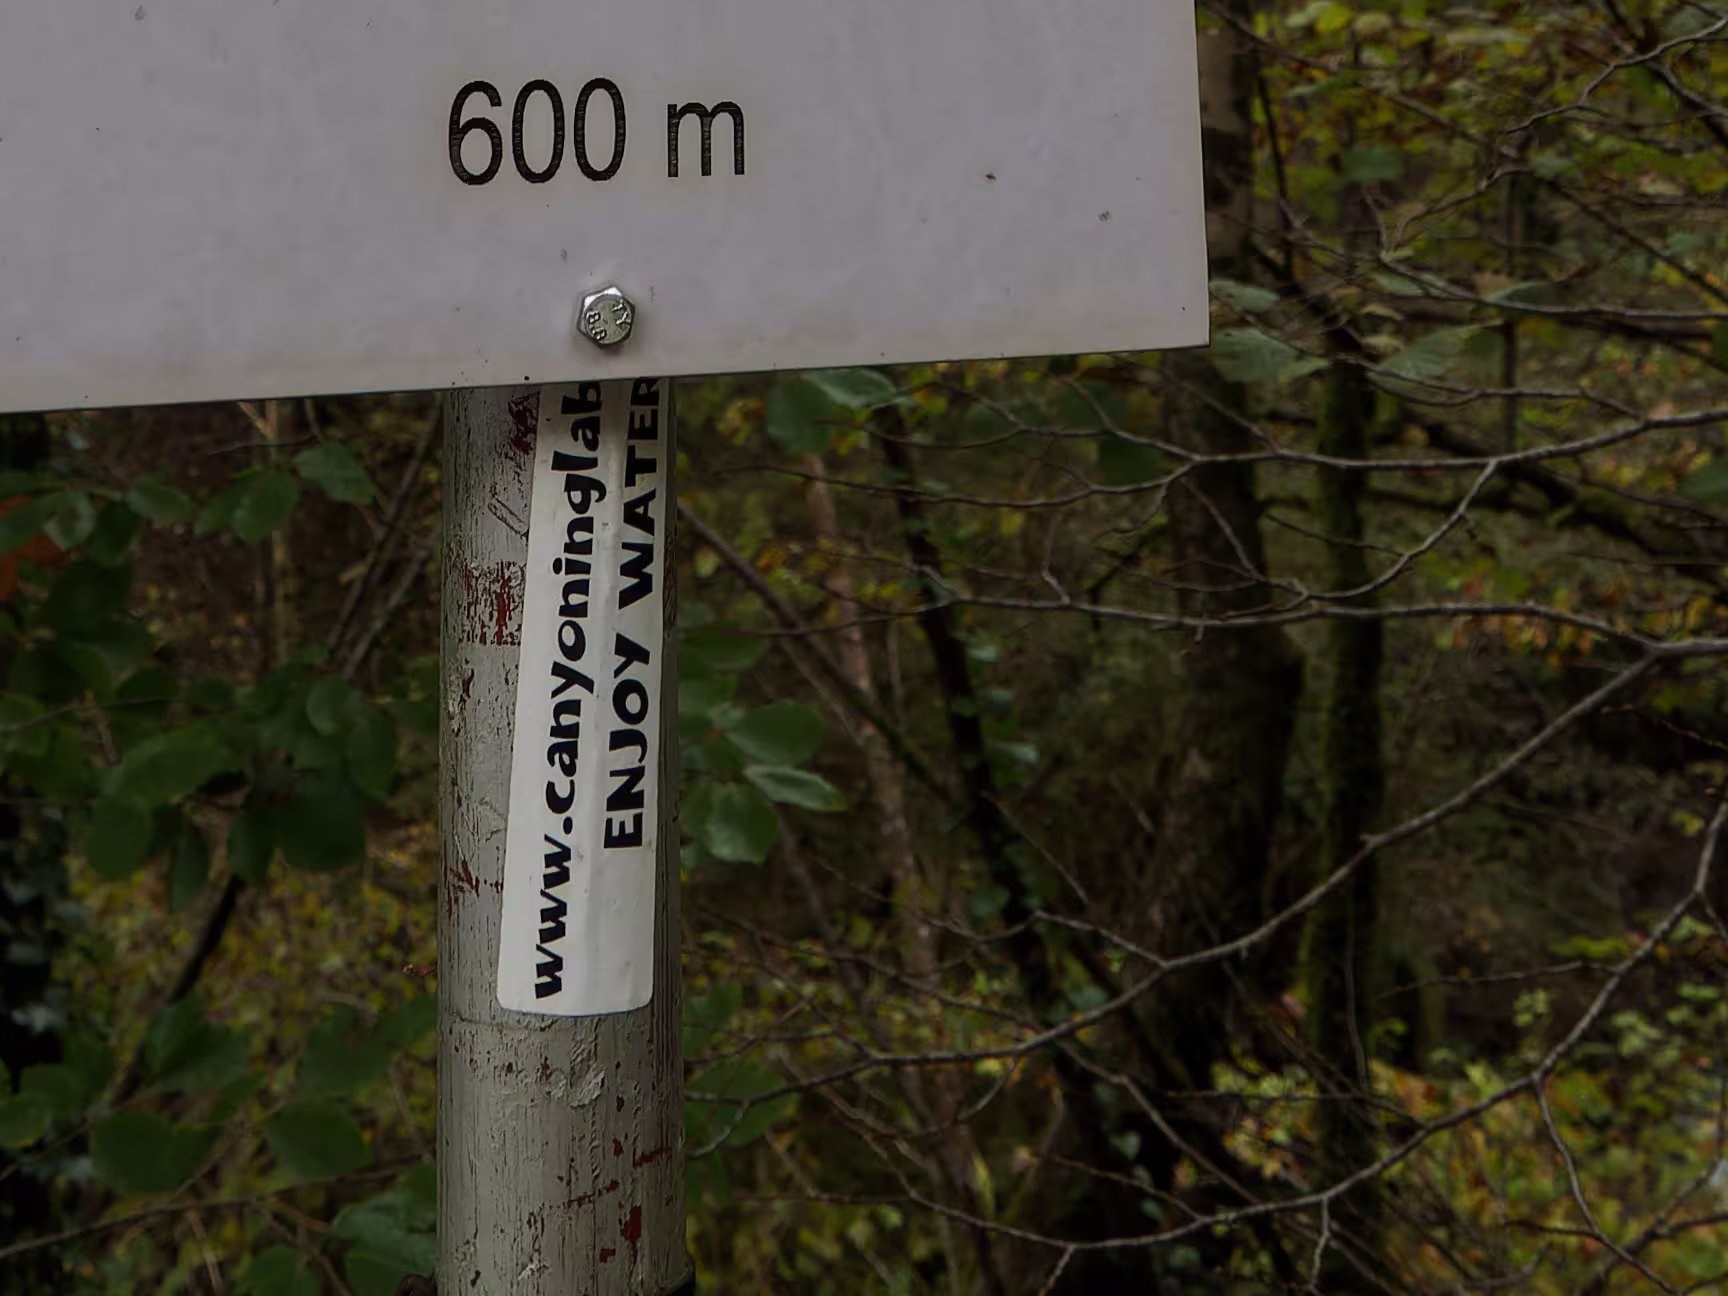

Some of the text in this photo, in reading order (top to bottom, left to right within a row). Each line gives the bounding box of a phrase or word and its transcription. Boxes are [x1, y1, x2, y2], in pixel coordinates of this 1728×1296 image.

[446, 77, 746, 186] 600 m
[604, 379, 660, 850] ENJOY WATER
